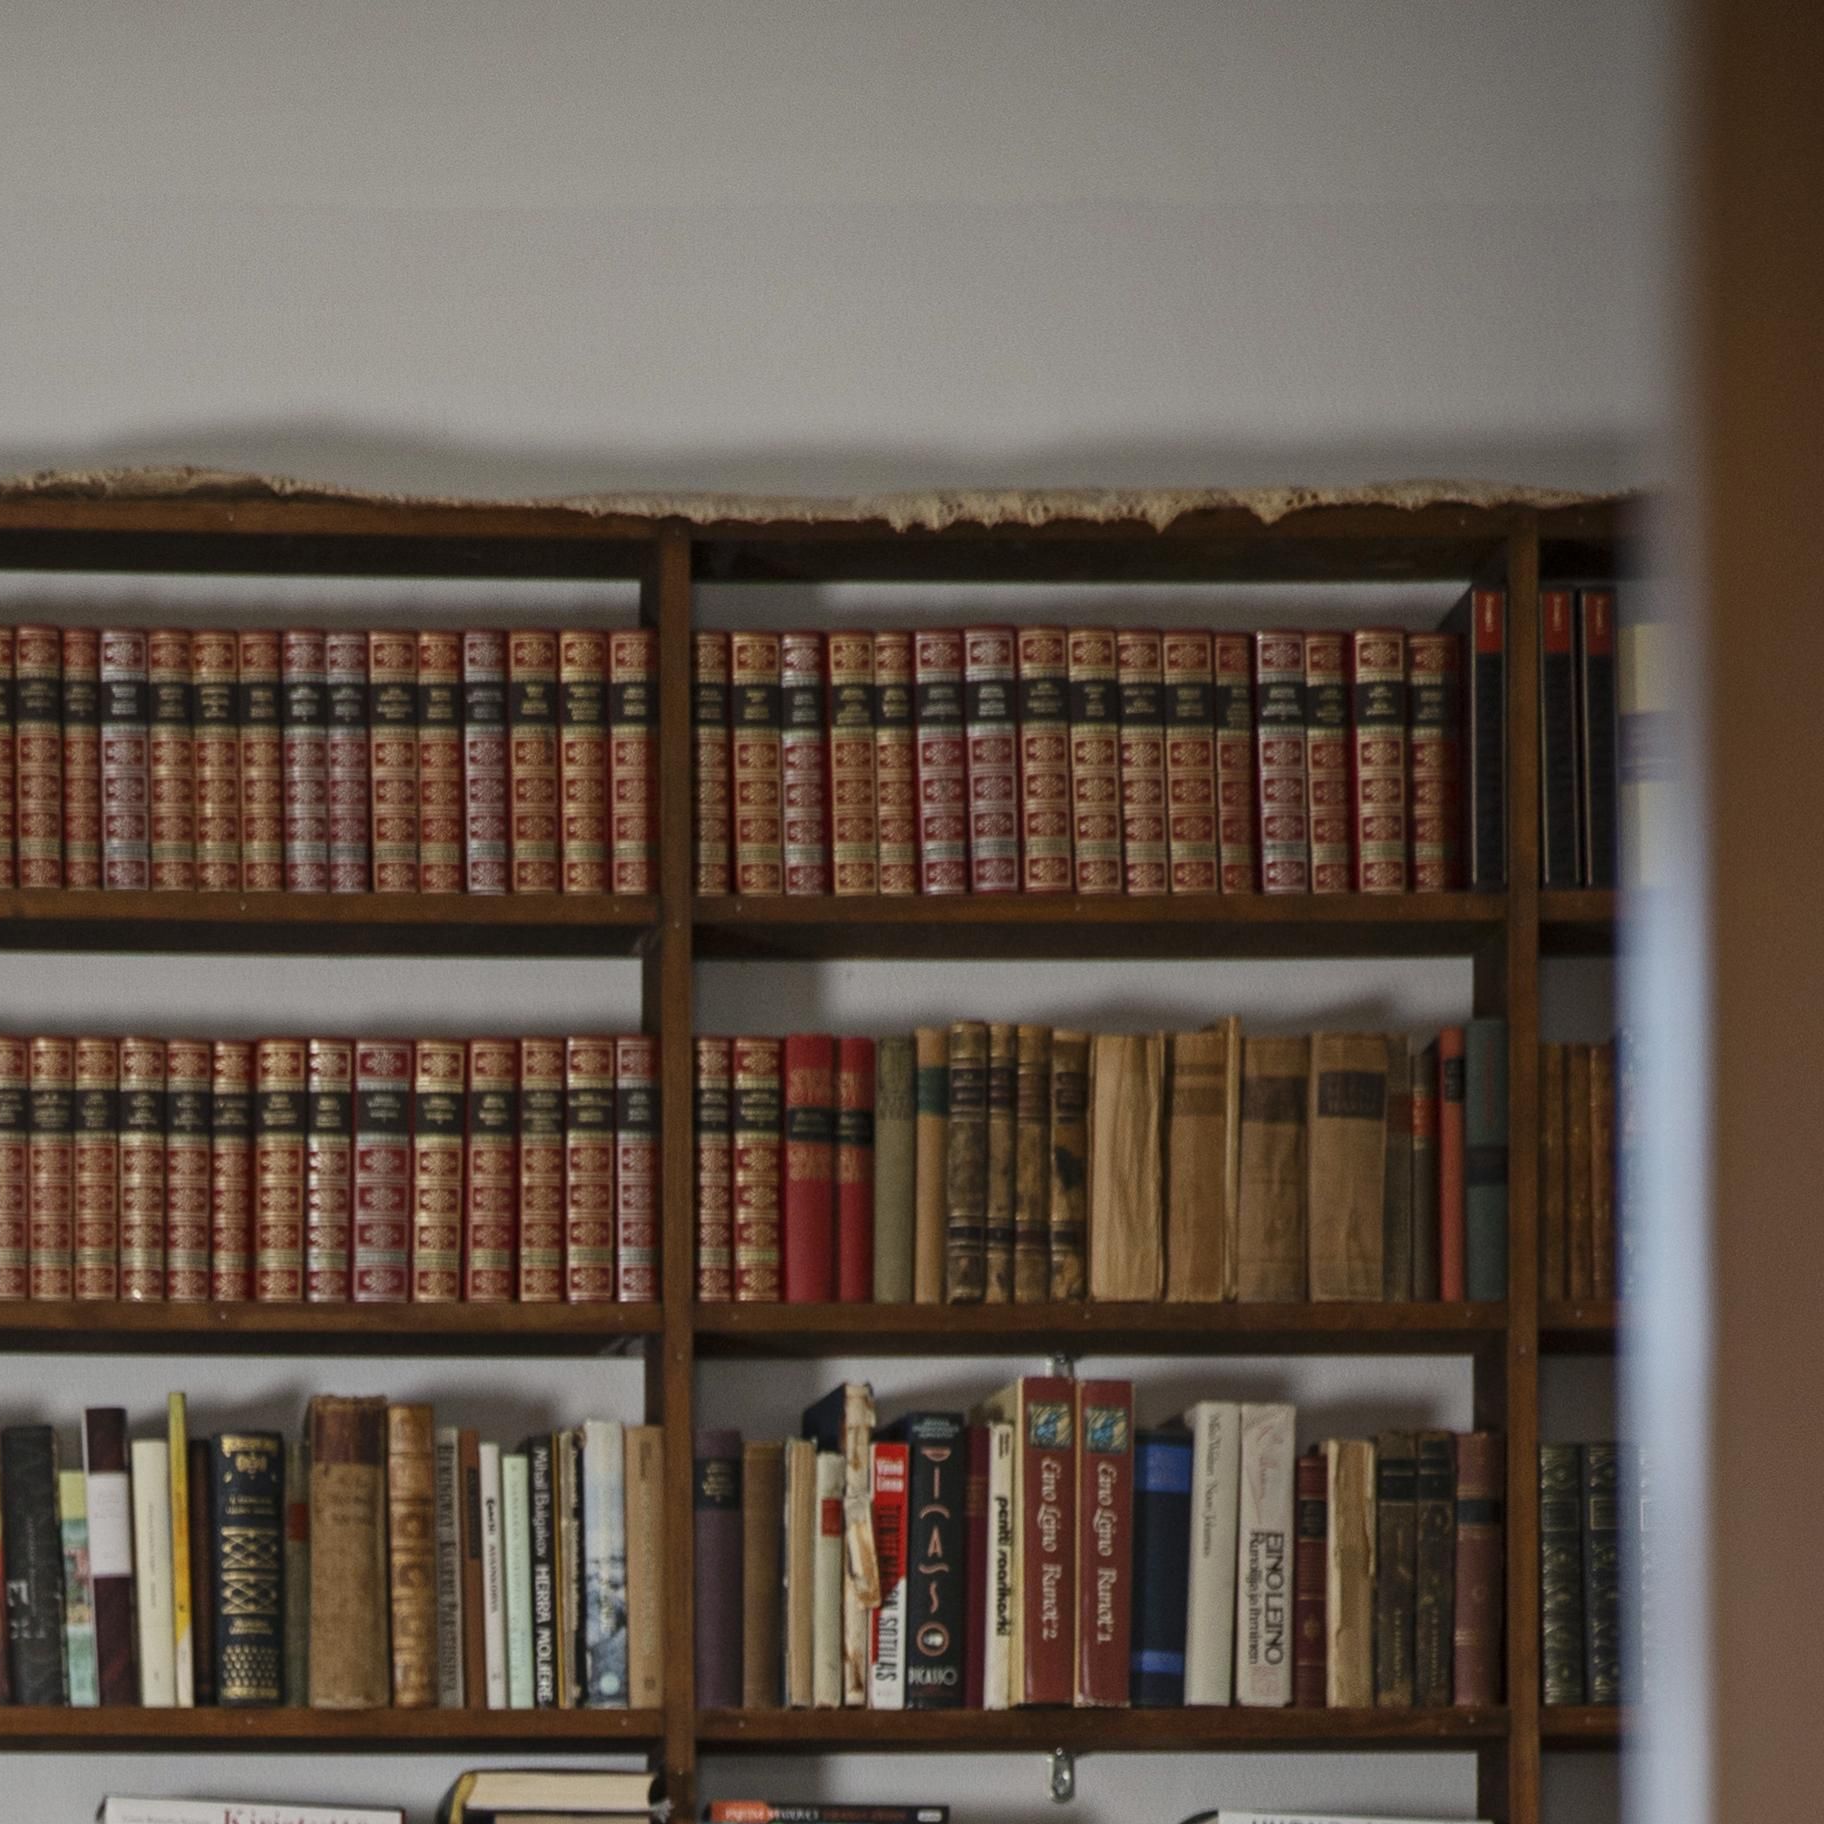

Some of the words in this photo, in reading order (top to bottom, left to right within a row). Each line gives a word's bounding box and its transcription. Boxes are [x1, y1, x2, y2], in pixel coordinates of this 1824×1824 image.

[534, 1449, 551, 1491] Mihail
[1042, 1457, 1062, 1502] Eino
[1097, 1461, 1118, 1506] Eino
[530, 1494, 552, 1559] Bulgakov
[1036, 1503, 1062, 1553] Leino
[1092, 1506, 1118, 1557] Leino
[1264, 1531, 1286, 1592] EINO
[535, 1564, 552, 1624] HERRA
[875, 1617, 898, 1682] SOTILAS
[1264, 1593, 1286, 1667] LEINO
